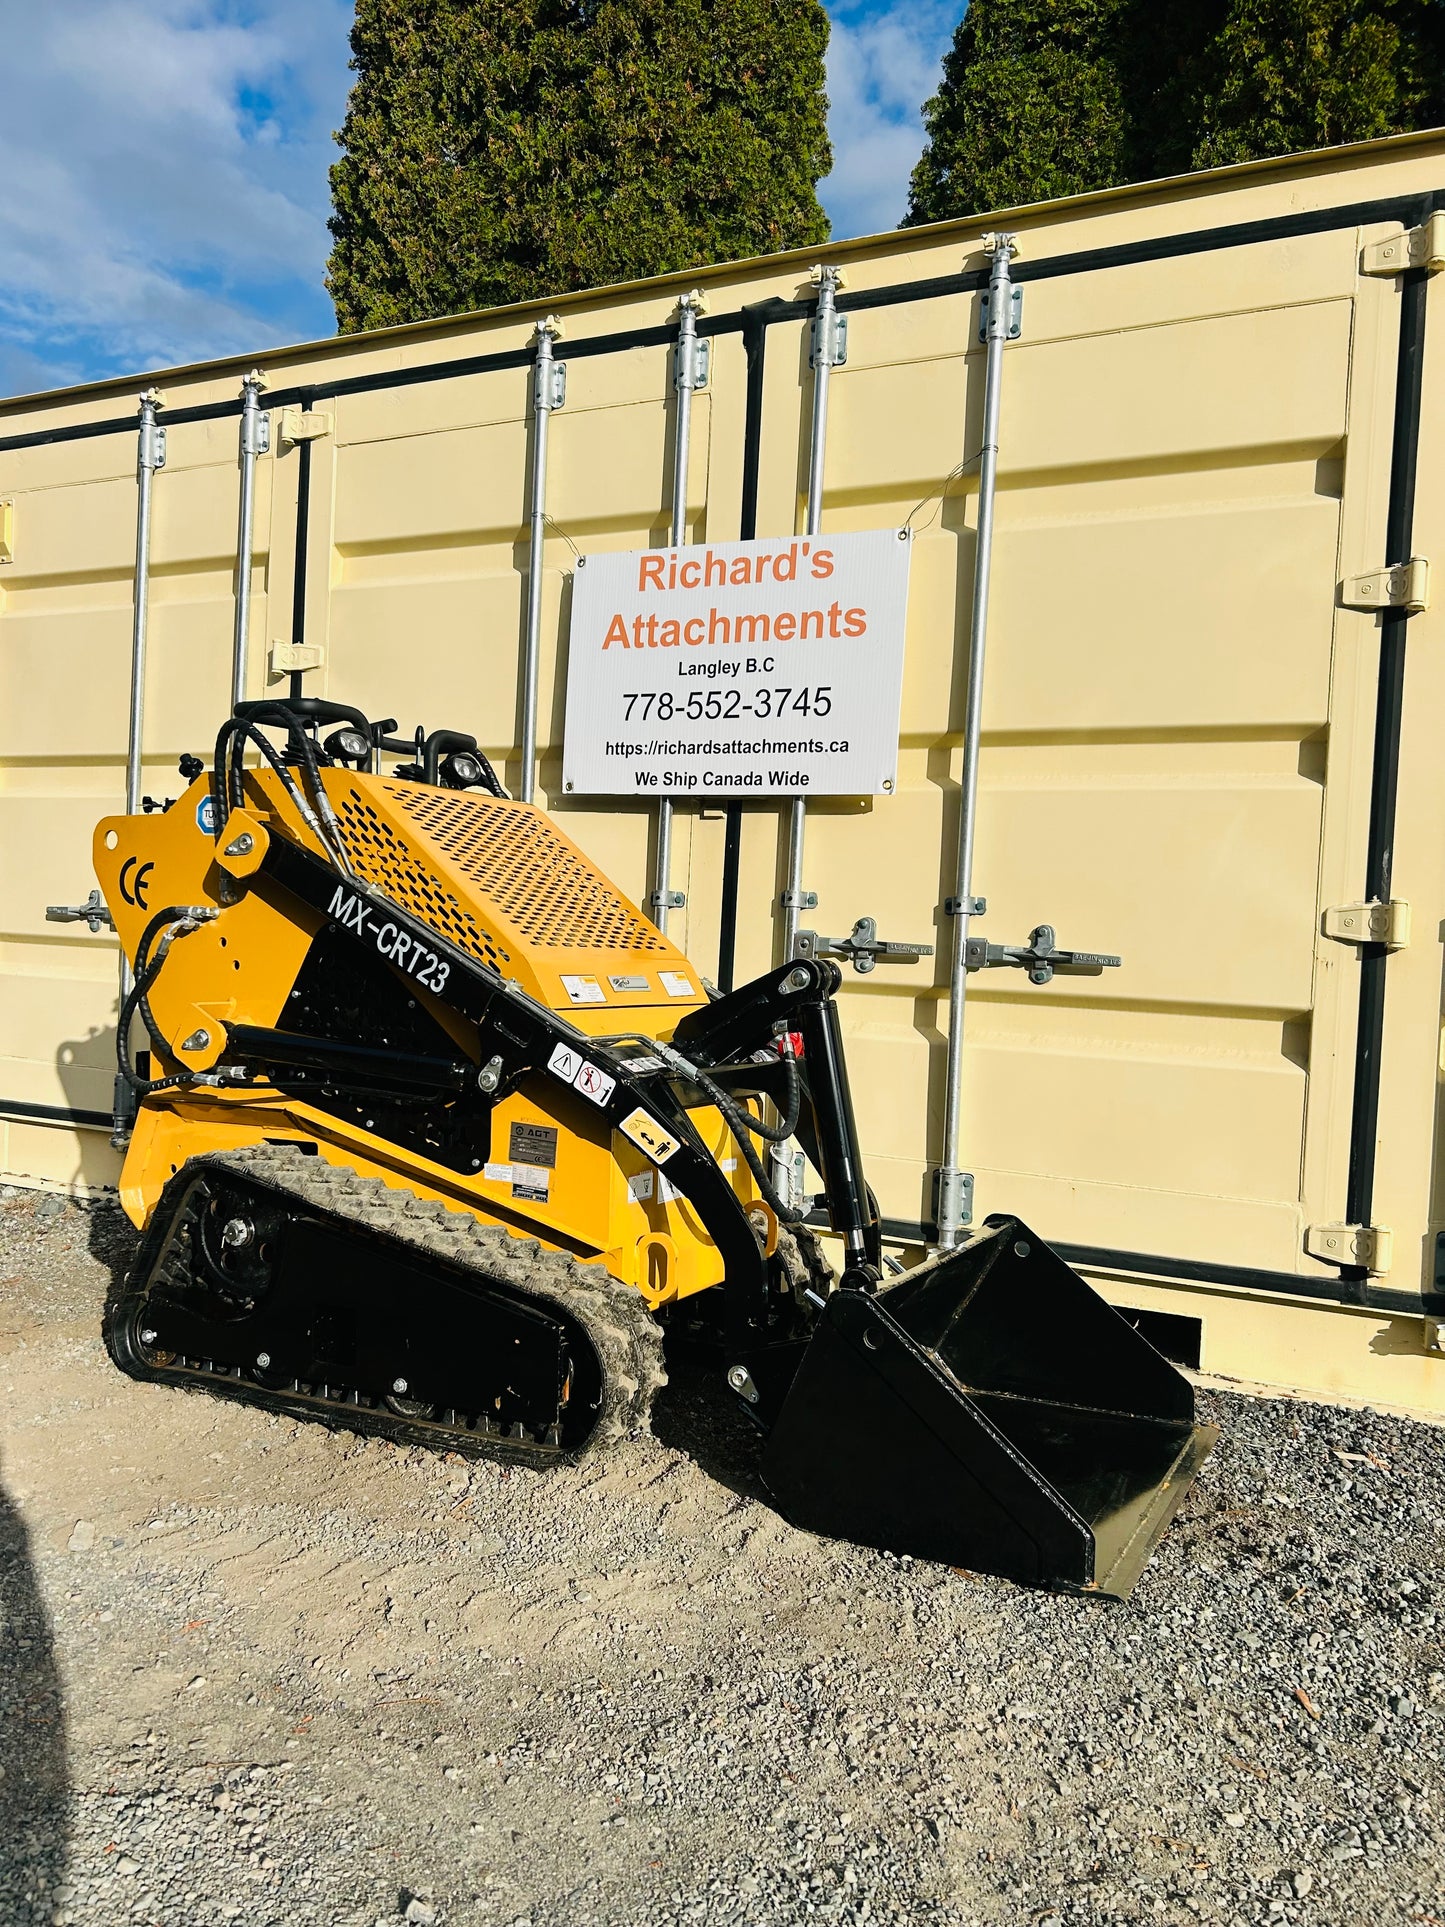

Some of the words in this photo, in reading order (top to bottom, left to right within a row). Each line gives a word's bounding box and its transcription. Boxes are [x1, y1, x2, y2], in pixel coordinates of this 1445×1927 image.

[638, 542, 835, 592] Richard's
[601, 601, 867, 650] Attachments
[678, 659, 740, 678] Langley
[746, 657, 775, 673] B.C
[622, 686, 832, 722] 778-552-3745
[605, 738, 849, 758] https://richardsattachments.ca
[635, 771, 658, 786] We
[662, 771, 698, 789] Ship
[702, 771, 762, 786] Canada
[768, 771, 810, 786] Wide
[119, 856, 154, 911] CE
[327, 885, 450, 993] MX-CRT23
[527, 1128, 551, 1139] AGT
